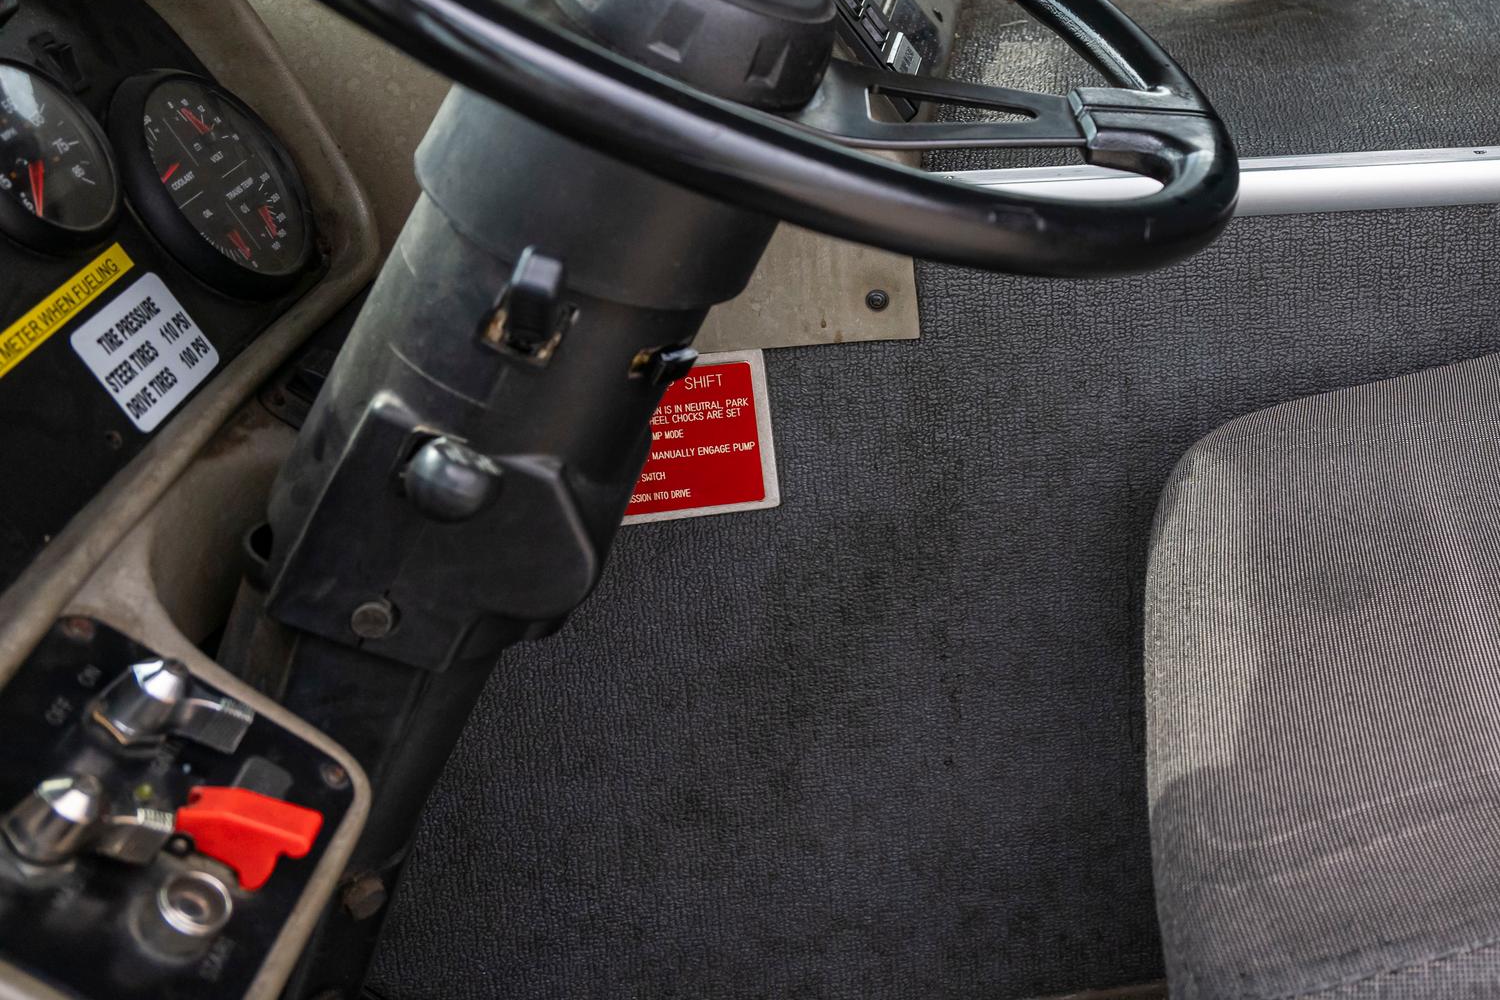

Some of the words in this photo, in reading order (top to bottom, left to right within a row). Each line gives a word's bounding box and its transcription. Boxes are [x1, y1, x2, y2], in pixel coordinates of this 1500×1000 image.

[52, 137, 70, 154] 75
[210, 151, 224, 163] VOLT
[171, 171, 195, 191] COOLANT
[0, 320, 43, 358] METER
[38, 292, 76, 327] WHEN
[72, 258, 119, 301] FUELING
[97, 328, 124, 355] TIRE
[115, 296, 161, 340] PRESSURE
[105, 360, 139, 393] STEER
[132, 340, 160, 371] TIRES
[159, 324, 175, 344] 110
[172, 311, 192, 337] PSI
[126, 386, 157, 420] DRIVE
[149, 367, 178, 396] TIRES
[179, 347, 197, 370] 100
[193, 336, 211, 359] PSI
[684, 373, 723, 390] SHIFT
[664, 405, 672, 414] IS
[674, 403, 683, 413] IN
[725, 398, 749, 408] PARK
[672, 412, 704, 423] CHOCKS
[706, 410, 724, 420] ARE
[726, 408, 742, 418] SET
[665, 429, 684, 439] MODE
[652, 448, 695, 460] MANUALLY
[697, 444, 731, 455] ENGAGE
[733, 441, 756, 451] PUMP
[641, 472, 666, 482] SWITCH
[654, 491, 669, 501] INTO
[671, 488, 691, 498] DRIVE
